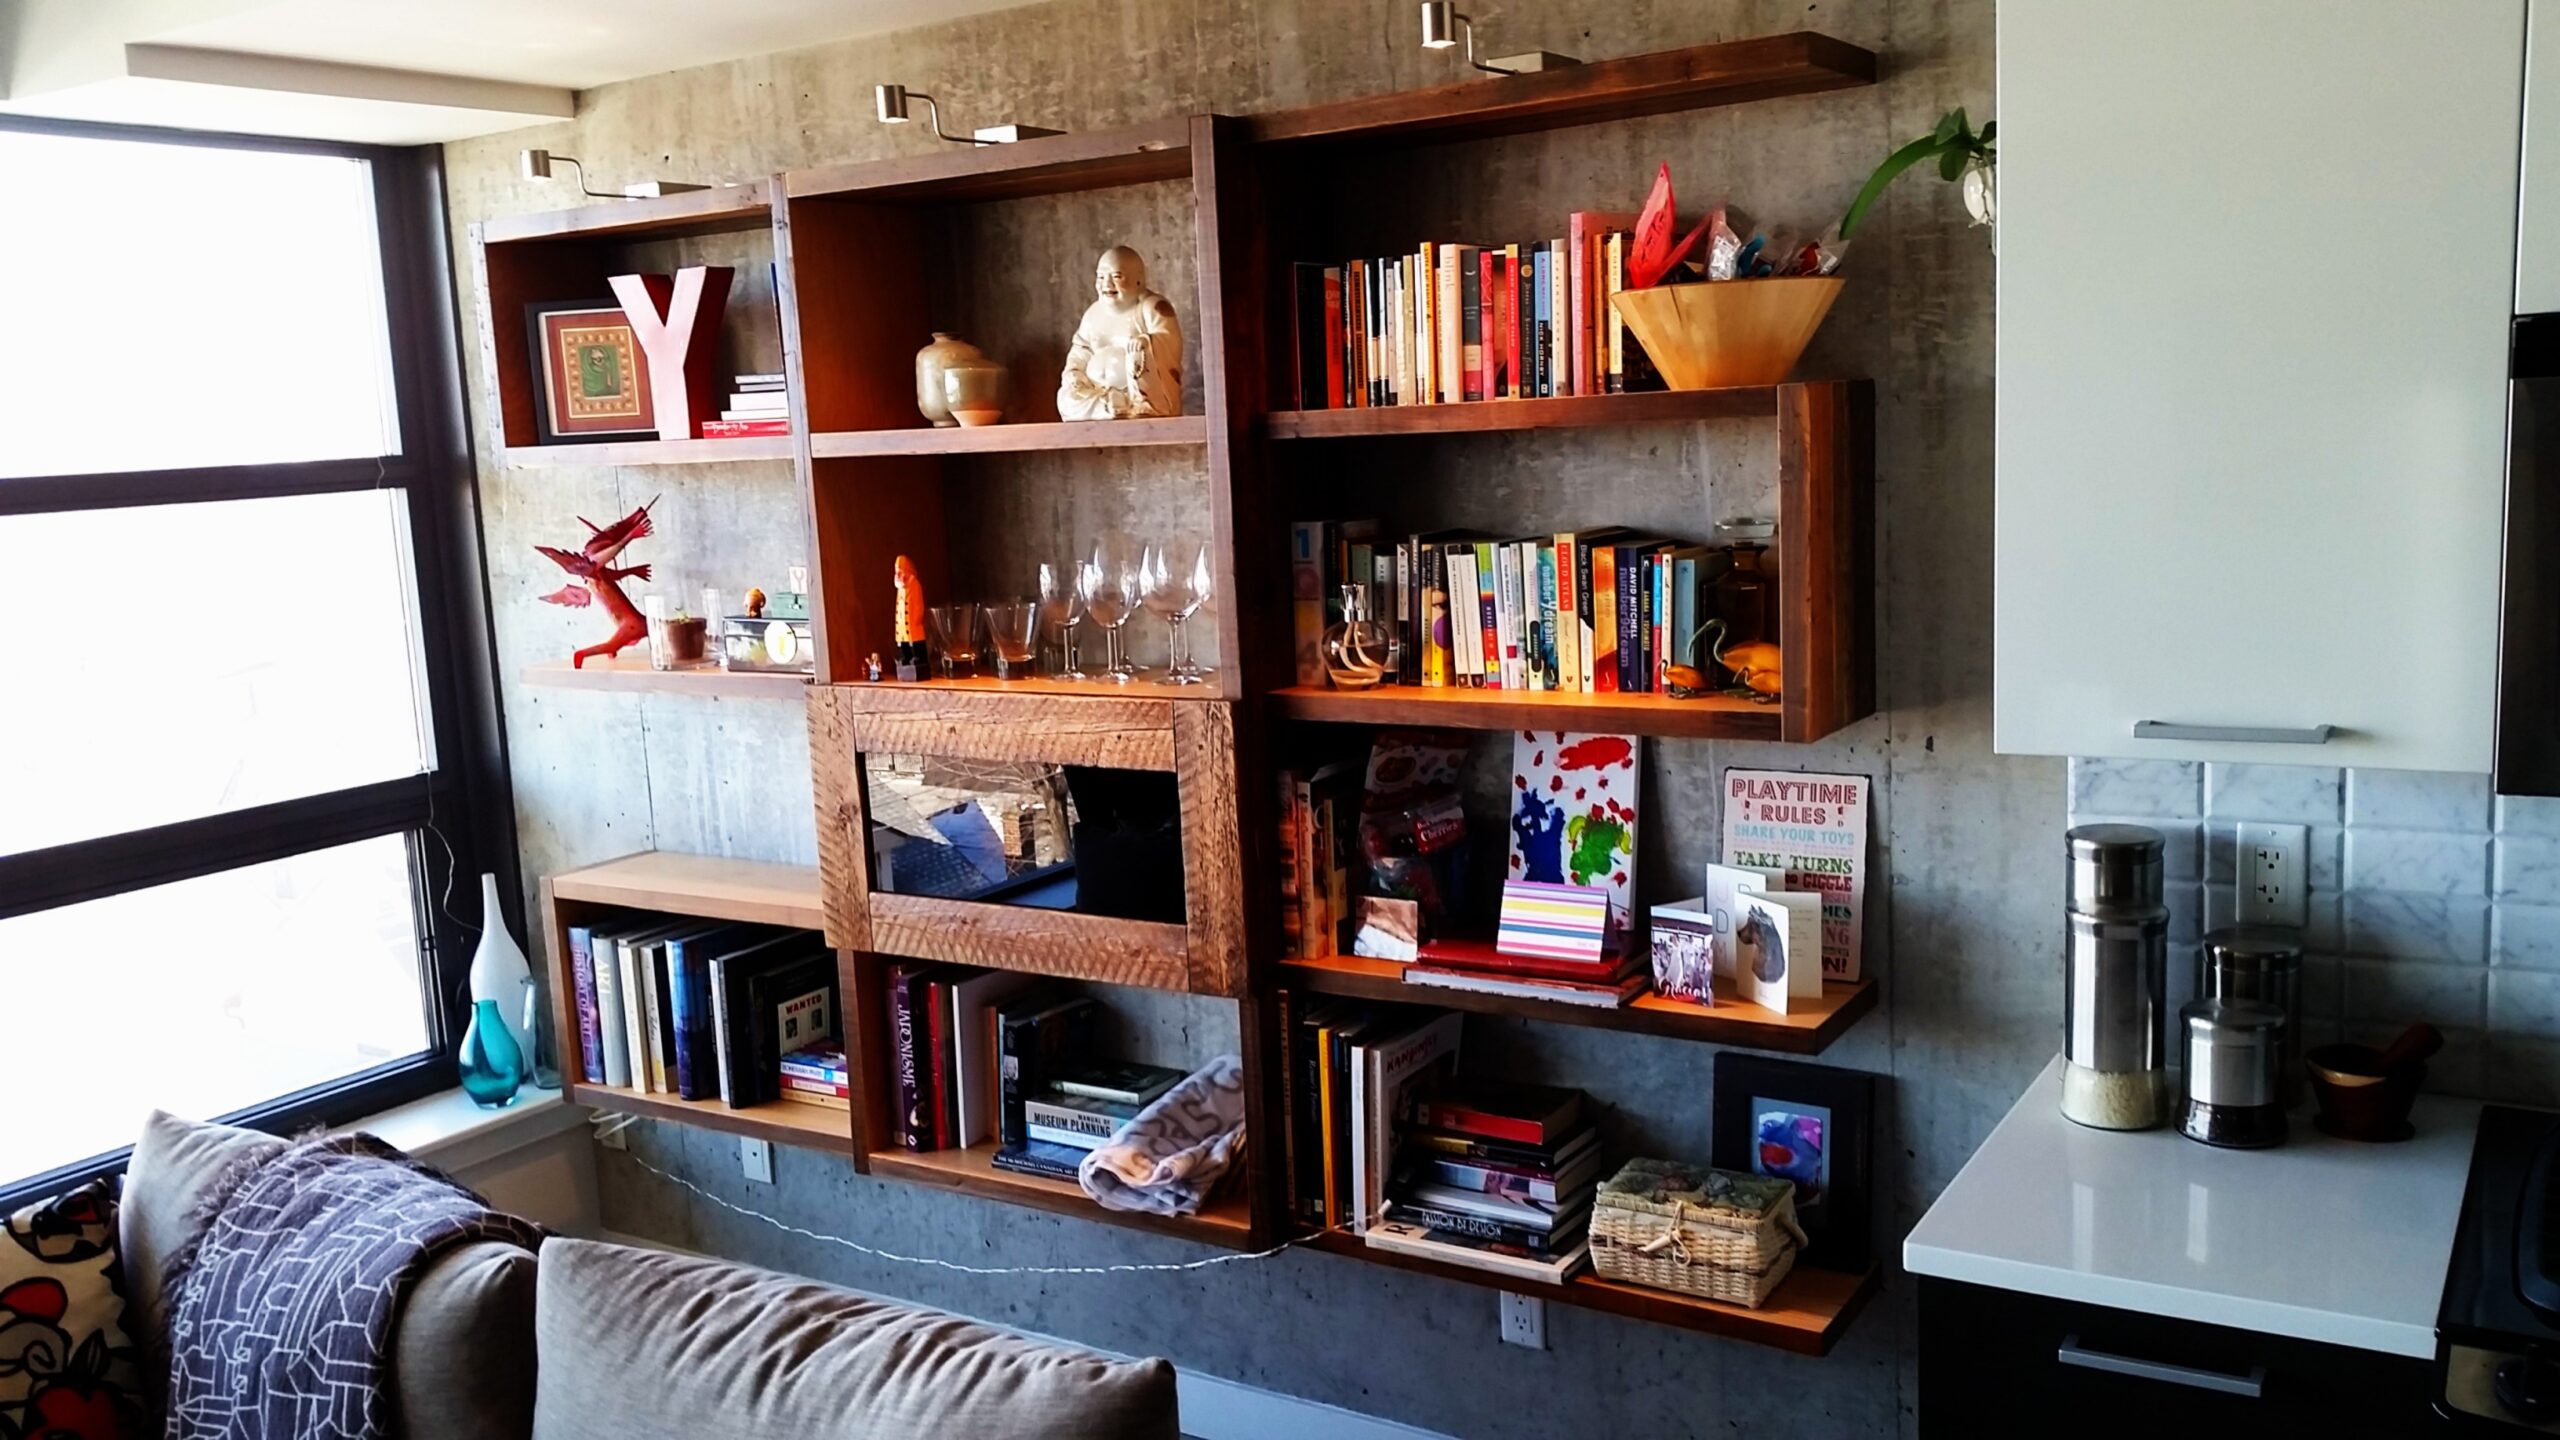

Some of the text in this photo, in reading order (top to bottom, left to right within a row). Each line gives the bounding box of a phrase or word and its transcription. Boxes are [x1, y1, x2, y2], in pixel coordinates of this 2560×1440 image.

[608, 267, 712, 440] Y
[1580, 544, 1588, 566] Black
[1561, 545, 1571, 610] CLOUD ATLAS
[1581, 570, 1589, 590] Swan
[1540, 566, 1558, 645] number9dream
[1582, 592, 1590, 616] Green
[1629, 567, 1638, 639] DAVID MITCHELL
[1619, 567, 1631, 668] number9dream
[1731, 778, 1857, 805] PLAYTIME
[1760, 804, 1826, 825] RULES
[1733, 823, 1855, 846] SHARE YOUR TOYS
[1733, 850, 1854, 875] TAKE TURNS
[1802, 874, 1853, 892] GIGGLE
[596, 958, 612, 995] ART
[785, 994, 823, 1015] WANTED
[897, 1004, 916, 1088] JAPONISME
[1033, 1112, 1069, 1130] MUSEUM
[1070, 1119, 1112, 1138] PLANNING
[1077, 1113, 1111, 1126] MANUAL OF
[1421, 1210, 1456, 1230] PASSION
[1467, 1219, 1502, 1237] DESIGN
